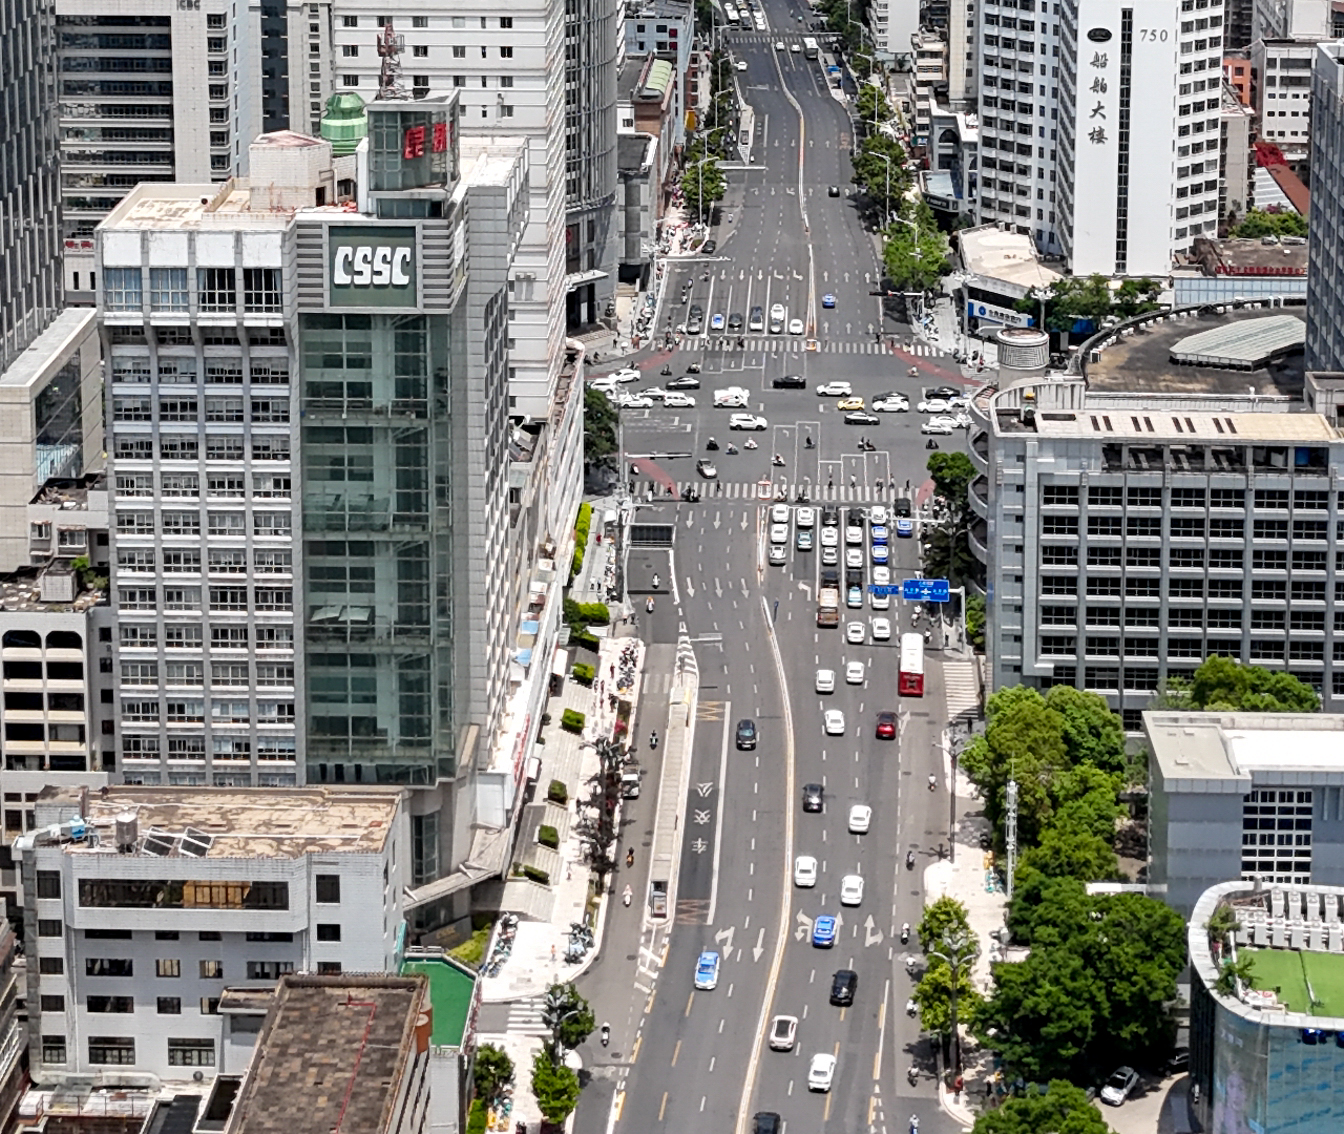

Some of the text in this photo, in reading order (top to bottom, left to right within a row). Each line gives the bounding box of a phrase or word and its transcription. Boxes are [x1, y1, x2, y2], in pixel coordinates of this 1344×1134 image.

[176, 0, 201, 11] ICBC
[1140, 29, 1168, 42] 750
[1088, 51, 1109, 145] 船舶大楼
[334, 246, 411, 285] CSSC
